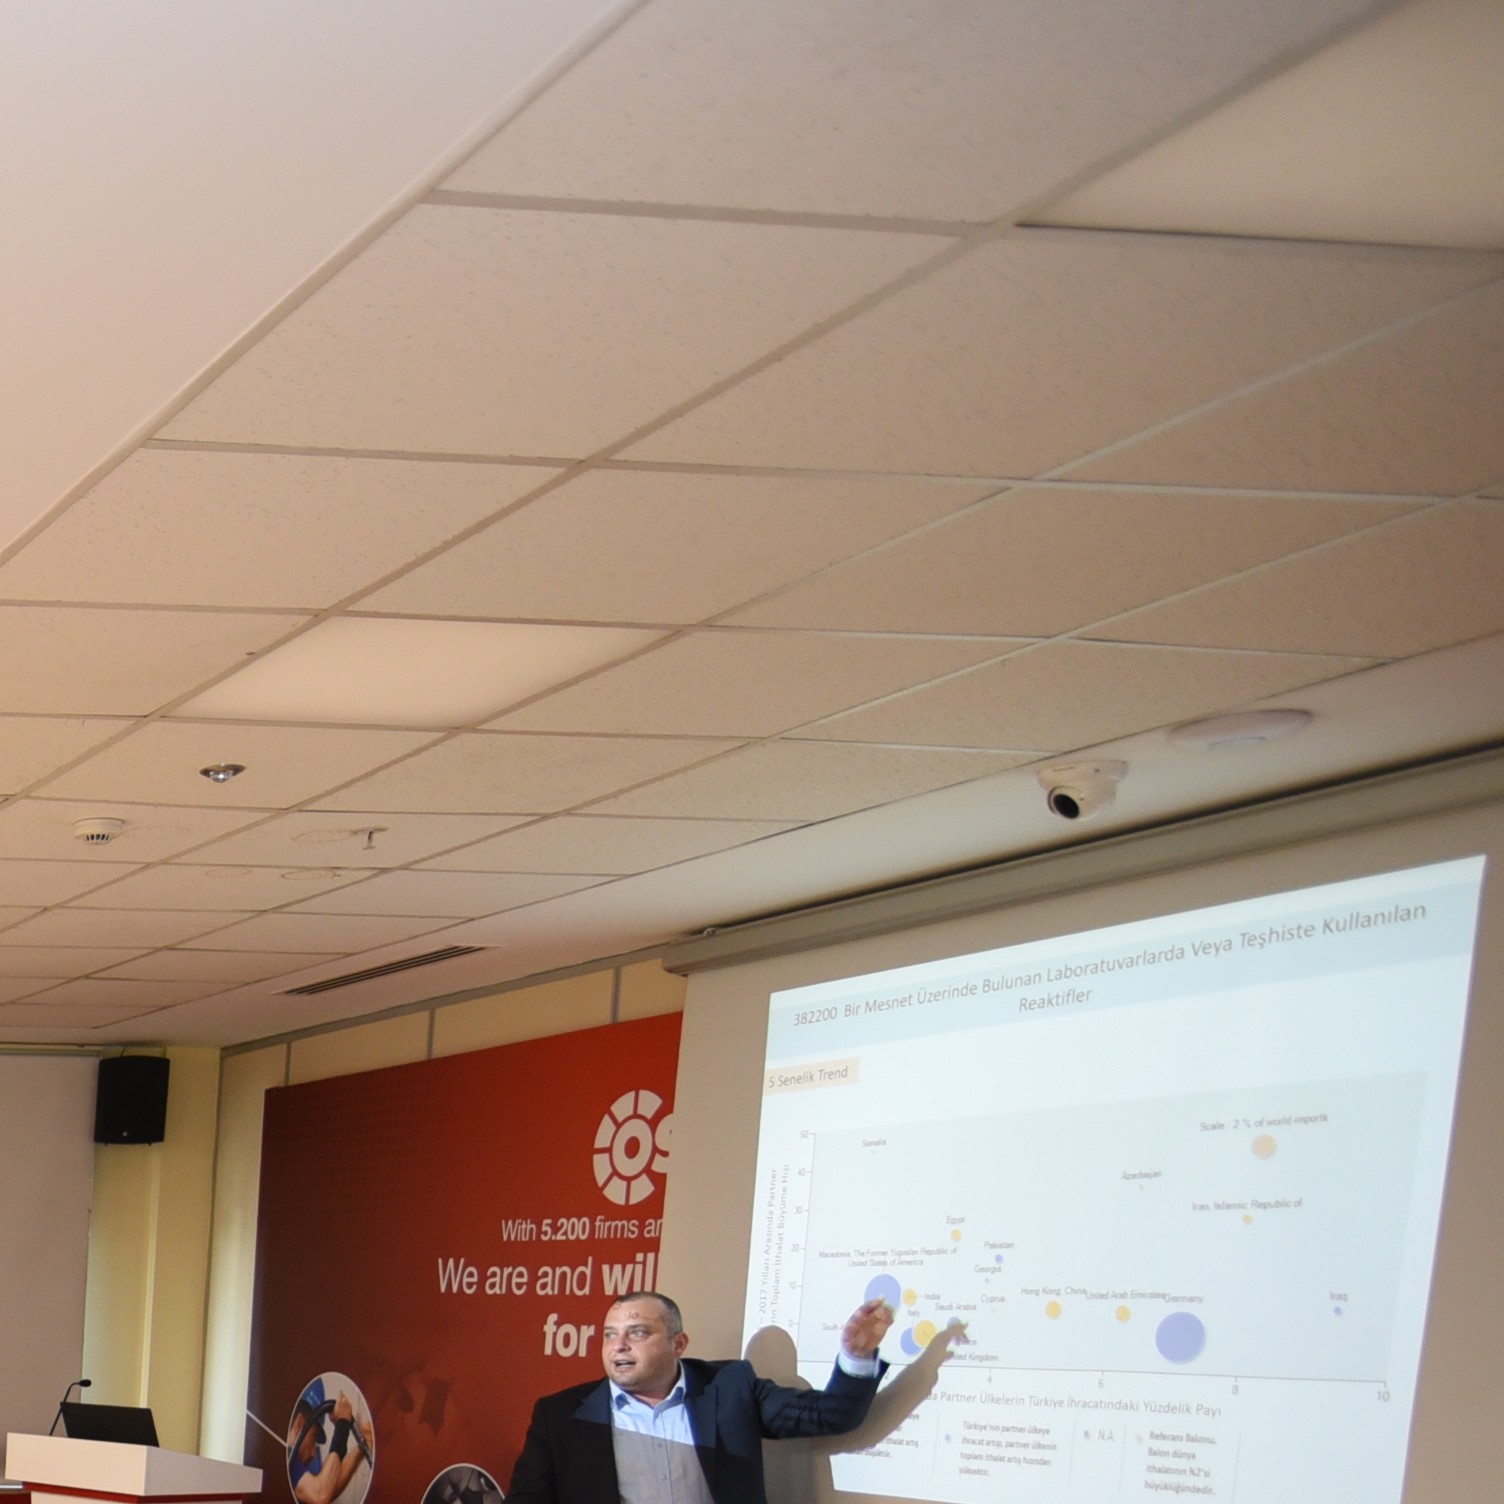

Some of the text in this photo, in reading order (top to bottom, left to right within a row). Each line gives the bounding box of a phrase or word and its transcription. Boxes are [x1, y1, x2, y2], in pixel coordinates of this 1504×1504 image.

[793, 904, 1427, 1027] 382200 Bir Mesnet Üzerinde Bulunan Laboratuvarlarda Veya Teşhiste Kullanılan
[1018, 988, 1093, 1013] Reaktifler
[768, 1065, 849, 1088] 5 Senelik Trend
[767, 1169, 777, 1207] Partner
[501, 1218, 537, 1243] With
[540, 1216, 590, 1241] 5.200
[594, 1214, 640, 1239] firms
[437, 1252, 656, 1297] We are and wil
[771, 1269, 781, 1306] Toplam
[543, 1313, 596, 1358] for
[940, 1391, 977, 1404] Partner
[980, 1391, 1025, 1406] Ülkelerin
[1028, 1395, 1065, 1409] Türkiye
[1067, 1394, 1139, 1412] İhracatındaki
[1143, 1400, 1192, 1415] Yüzdelik
[1195, 1404, 1222, 1420] Payı
